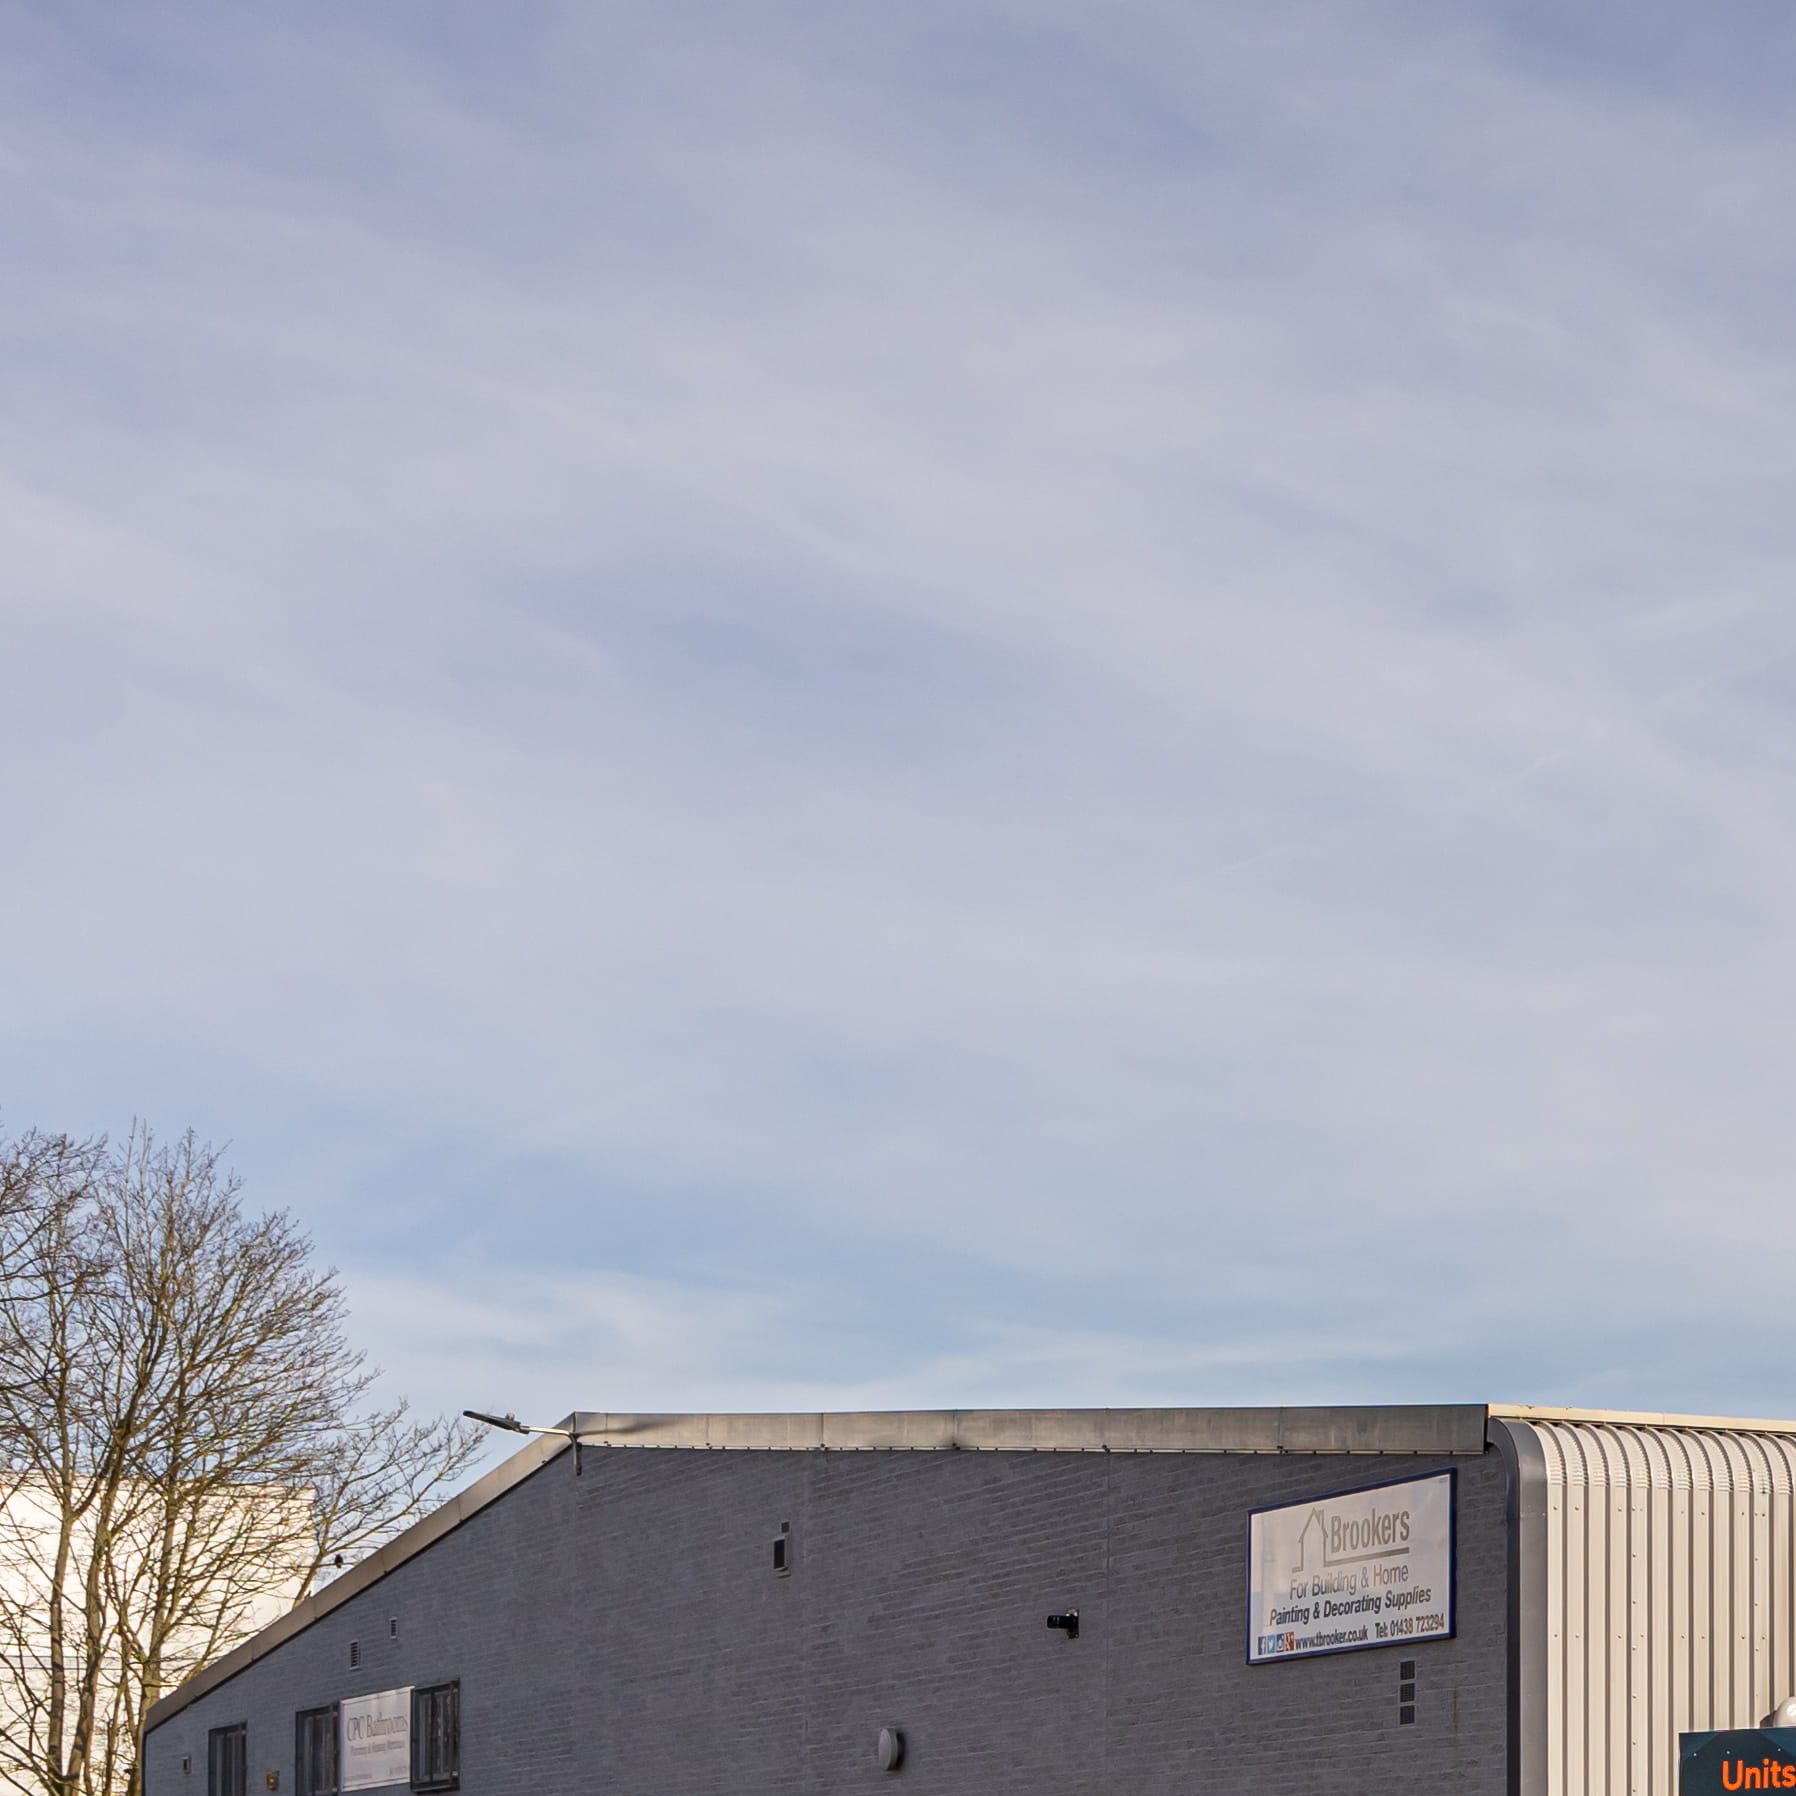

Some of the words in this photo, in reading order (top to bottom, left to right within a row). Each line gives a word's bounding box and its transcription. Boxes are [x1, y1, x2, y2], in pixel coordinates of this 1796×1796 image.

[1330, 1508, 1410, 1553] Brookers
[1289, 1578, 1311, 1601] For
[1312, 1571, 1357, 1597] Building
[1361, 1566, 1369, 1588] &
[1373, 1563, 1409, 1586] Home
[1269, 1605, 1310, 1627] Painting
[1313, 1601, 1320, 1619] &
[1323, 1593, 1382, 1616] Decorating
[1385, 1585, 1432, 1611] Supplies
[1390, 1618, 1413, 1638] 01438
[1415, 1613, 1445, 1635] 723294
[1722, 1758, 1796, 1791] Units
